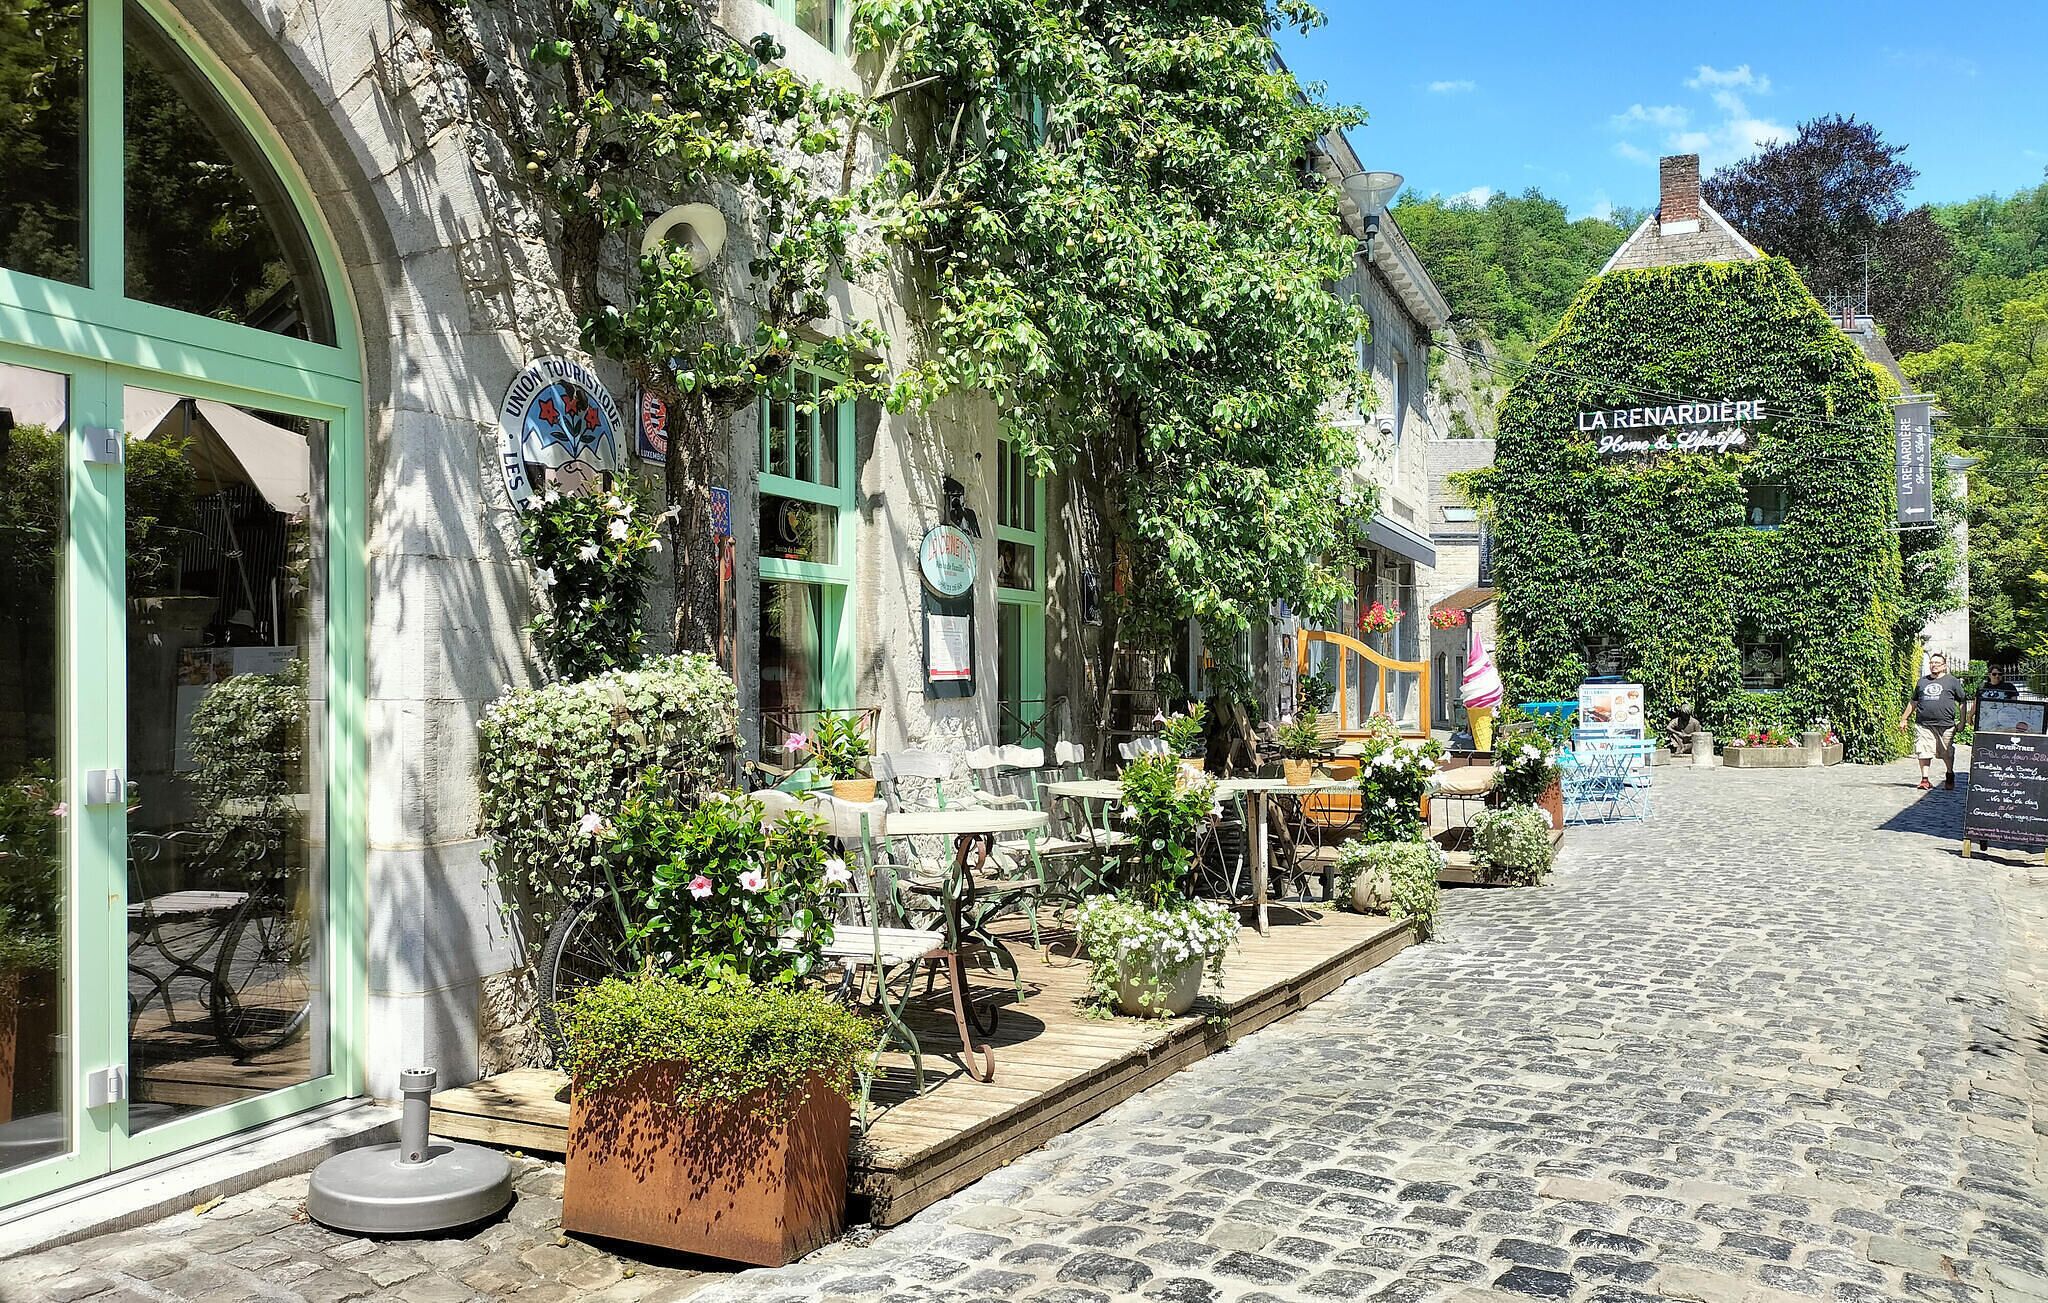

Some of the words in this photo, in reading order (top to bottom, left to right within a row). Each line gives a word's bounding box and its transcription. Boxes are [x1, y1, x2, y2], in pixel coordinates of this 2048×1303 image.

[506, 366, 543, 418] UNION
[543, 359, 621, 432] TOURISTIQUE
[1578, 411, 1608, 431] LA
[1613, 397, 1767, 429] RENARDIÈRE
[1598, 434, 1650, 456] Home
[1652, 436, 1673, 451] &
[1675, 428, 1747, 456] Lifestyle
[1898, 417, 1913, 481] RENARDIÈRE
[503, 452, 525, 491] LES
[1902, 482, 1913, 495] LA
[1995, 743, 2035, 752] FEVER-TREE
